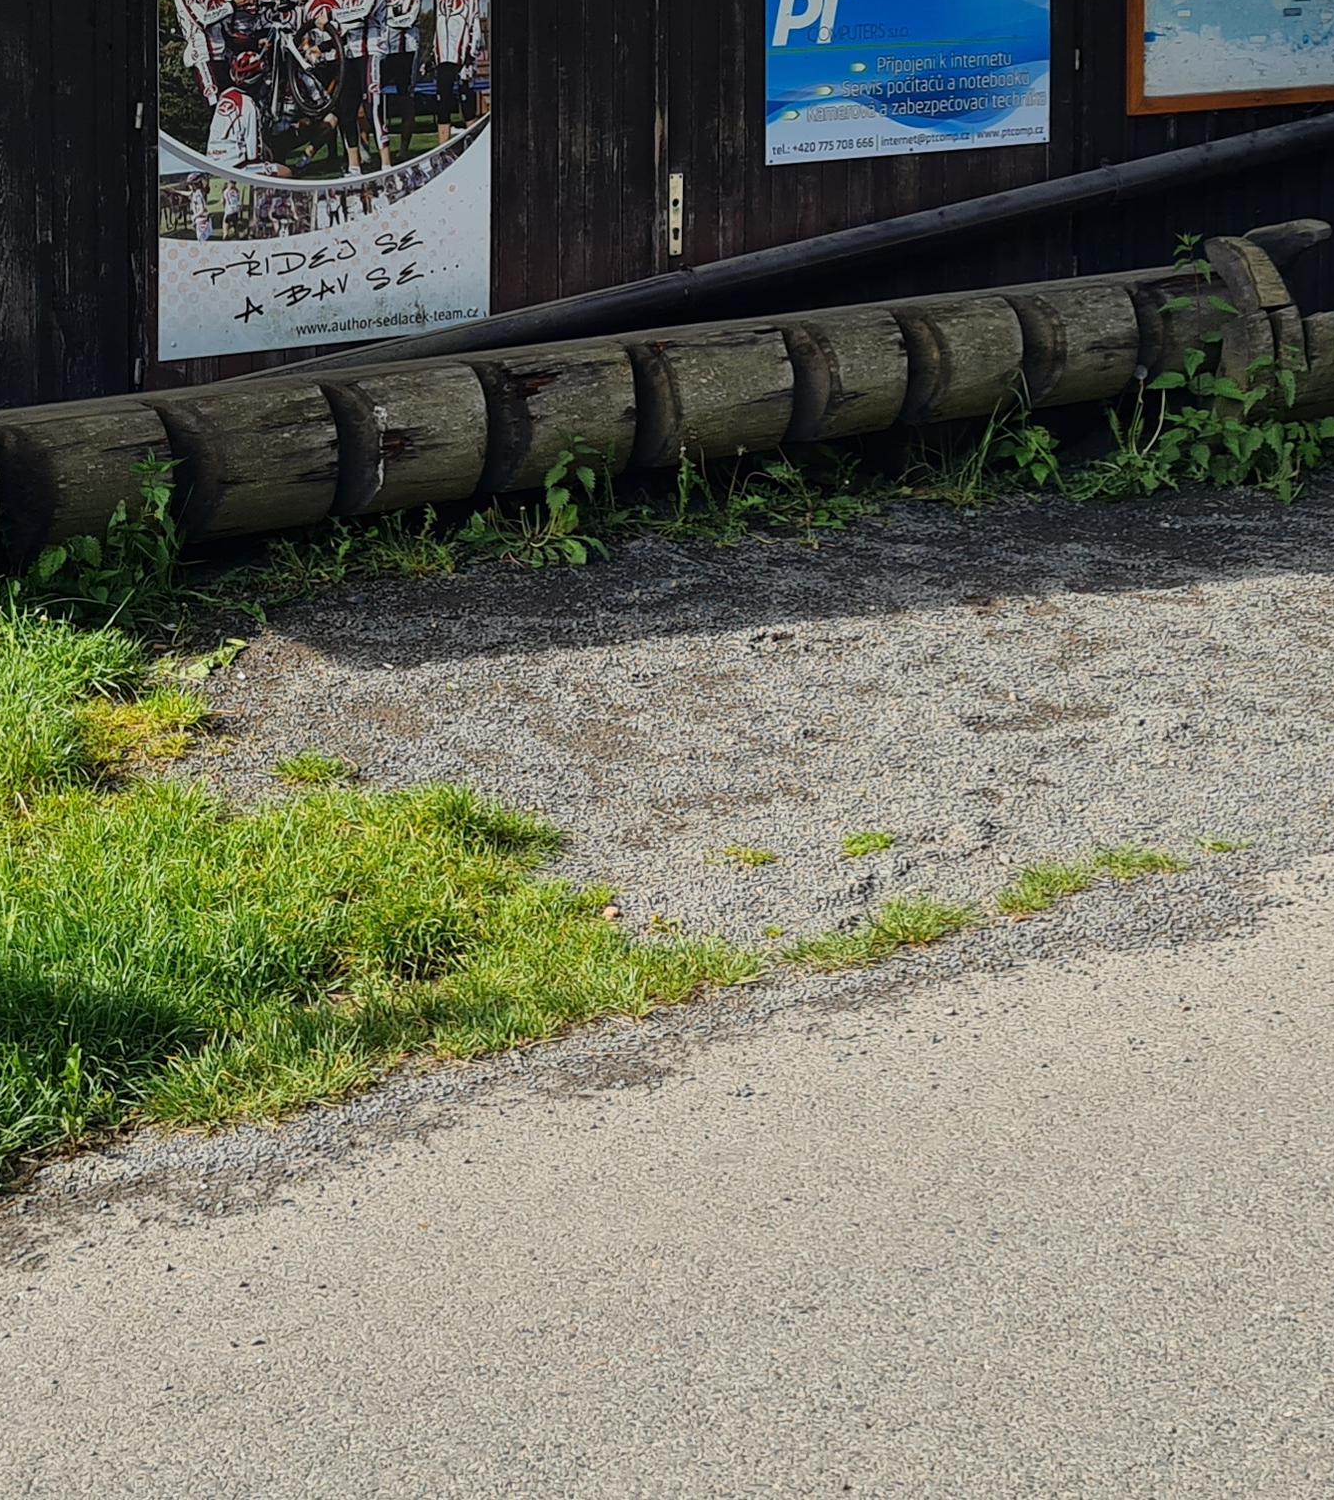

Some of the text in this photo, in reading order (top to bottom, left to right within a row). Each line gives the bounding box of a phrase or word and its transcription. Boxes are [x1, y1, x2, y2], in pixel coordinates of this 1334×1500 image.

[877, 51, 1012, 74] Připojení k internetu
[842, 80, 883, 98] Servis
[947, 77, 956, 90] a
[878, 104, 888, 116] a
[792, 141, 816, 154] +420
[818, 140, 835, 152] 775
[836, 138, 854, 151] 708
[856, 137, 875, 149] 666
[193, 229, 424, 286] PŘIDEJ SE
[233, 296, 264, 324] A
[274, 275, 348, 307] BAV
[295, 308, 480, 338] www.author-sedlacek-team.cz
